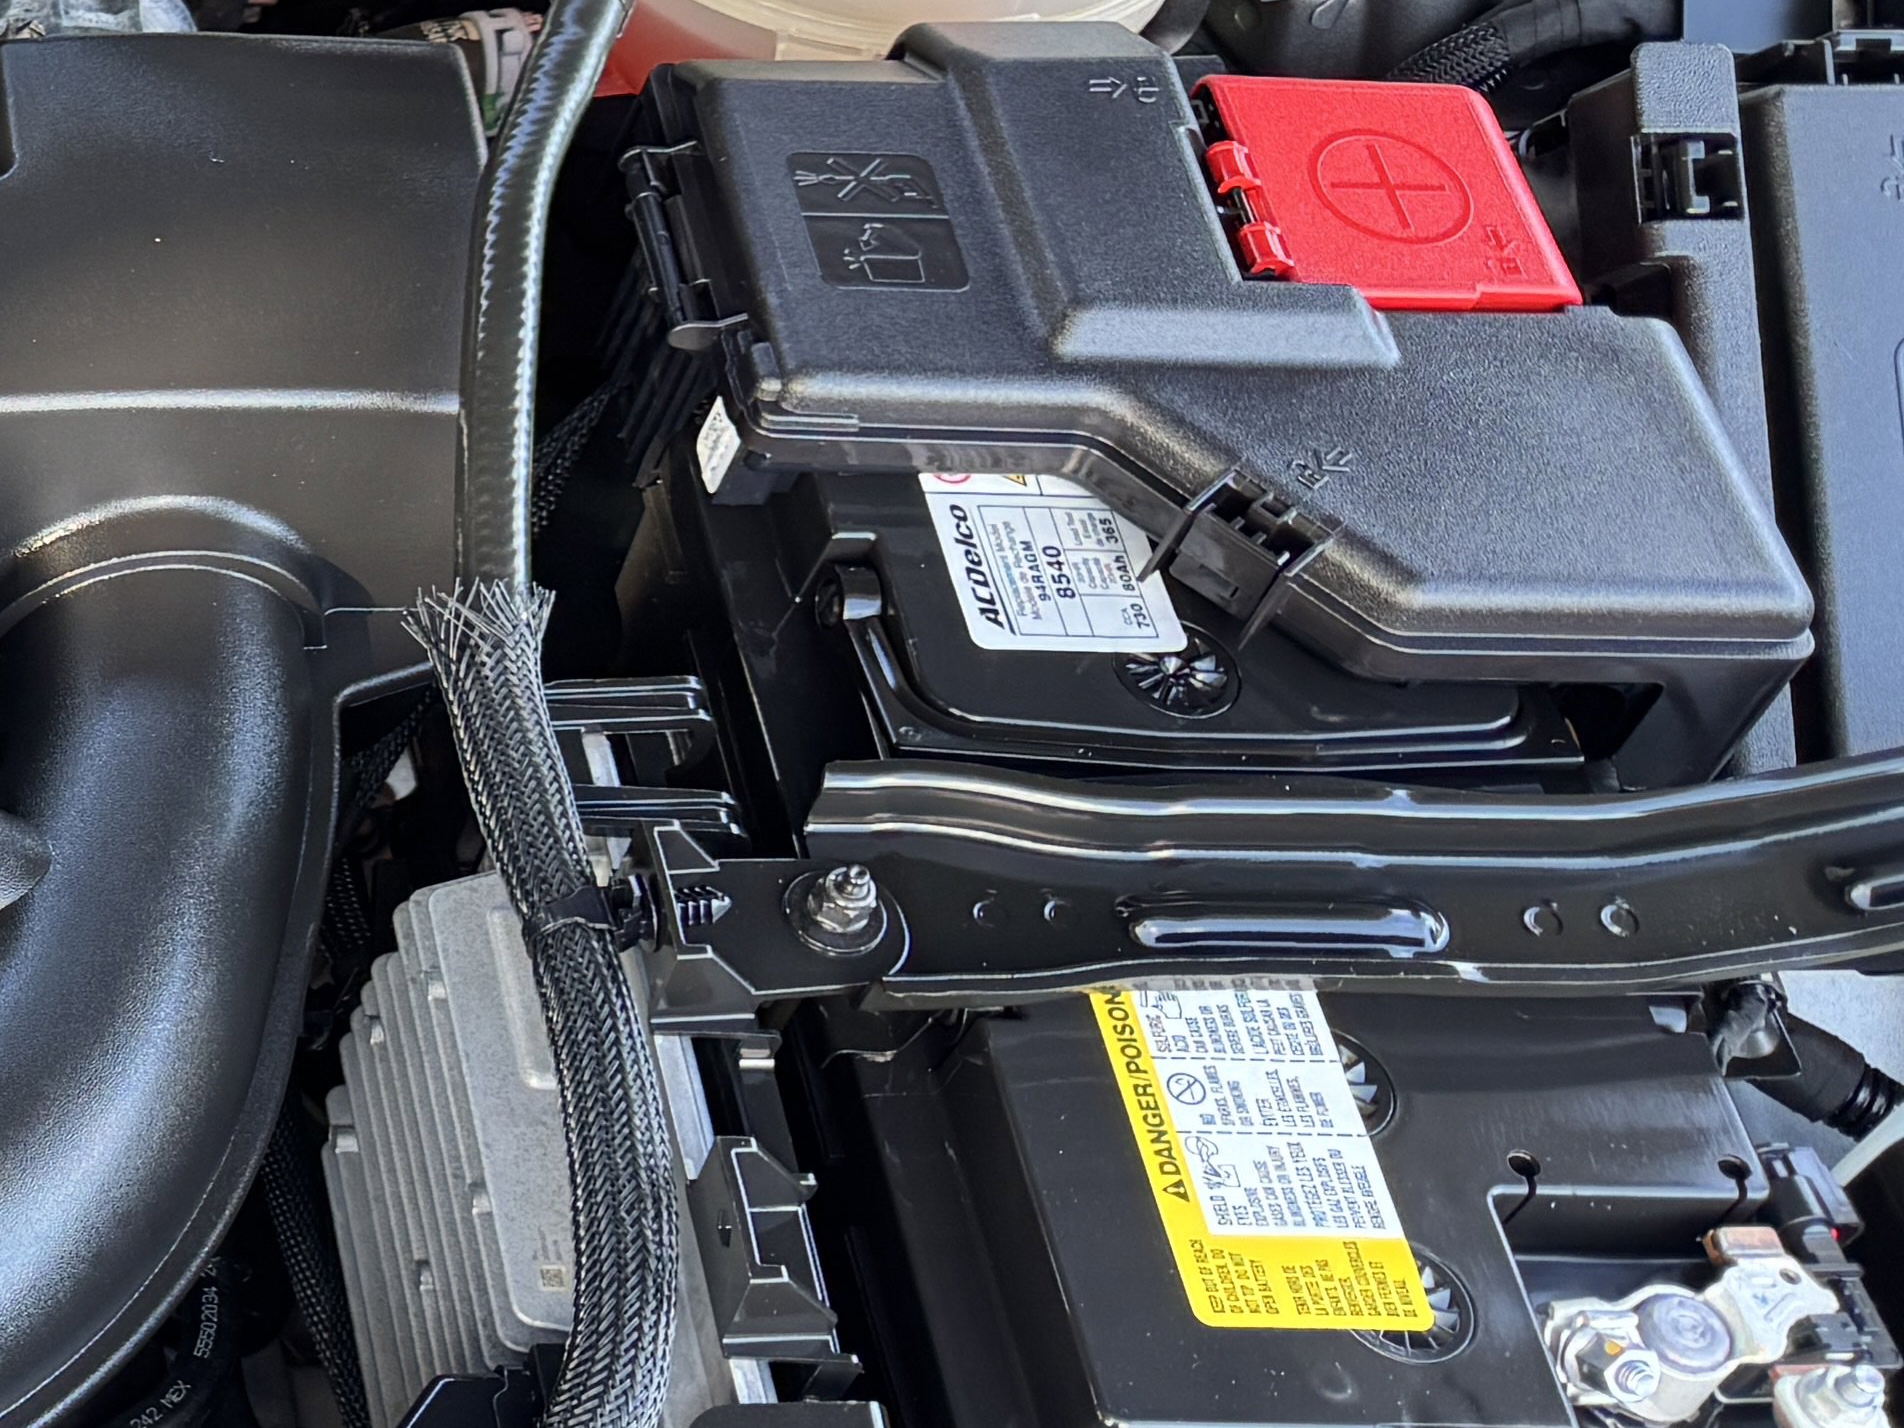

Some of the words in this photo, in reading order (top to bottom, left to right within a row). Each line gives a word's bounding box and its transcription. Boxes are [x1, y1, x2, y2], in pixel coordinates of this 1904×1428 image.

[989, 522, 1005, 553] Model
[1001, 520, 1023, 569] Rechange
[1098, 517, 1119, 544] 365
[949, 504, 1004, 628] ACDelco
[999, 554, 1027, 617] Replacement
[1018, 570, 1029, 584] de
[1019, 539, 1051, 601] 94RAGM
[1041, 544, 1076, 599] 8540
[1112, 554, 1135, 591] 80Ah
[1119, 606, 1133, 626] CCA
[1129, 602, 1150, 629] 730
[1102, 990, 1180, 1175] DANGER/POISON
[159, 1379, 192, 1412] MEX
[192, 1285, 220, 1359] 55502034
